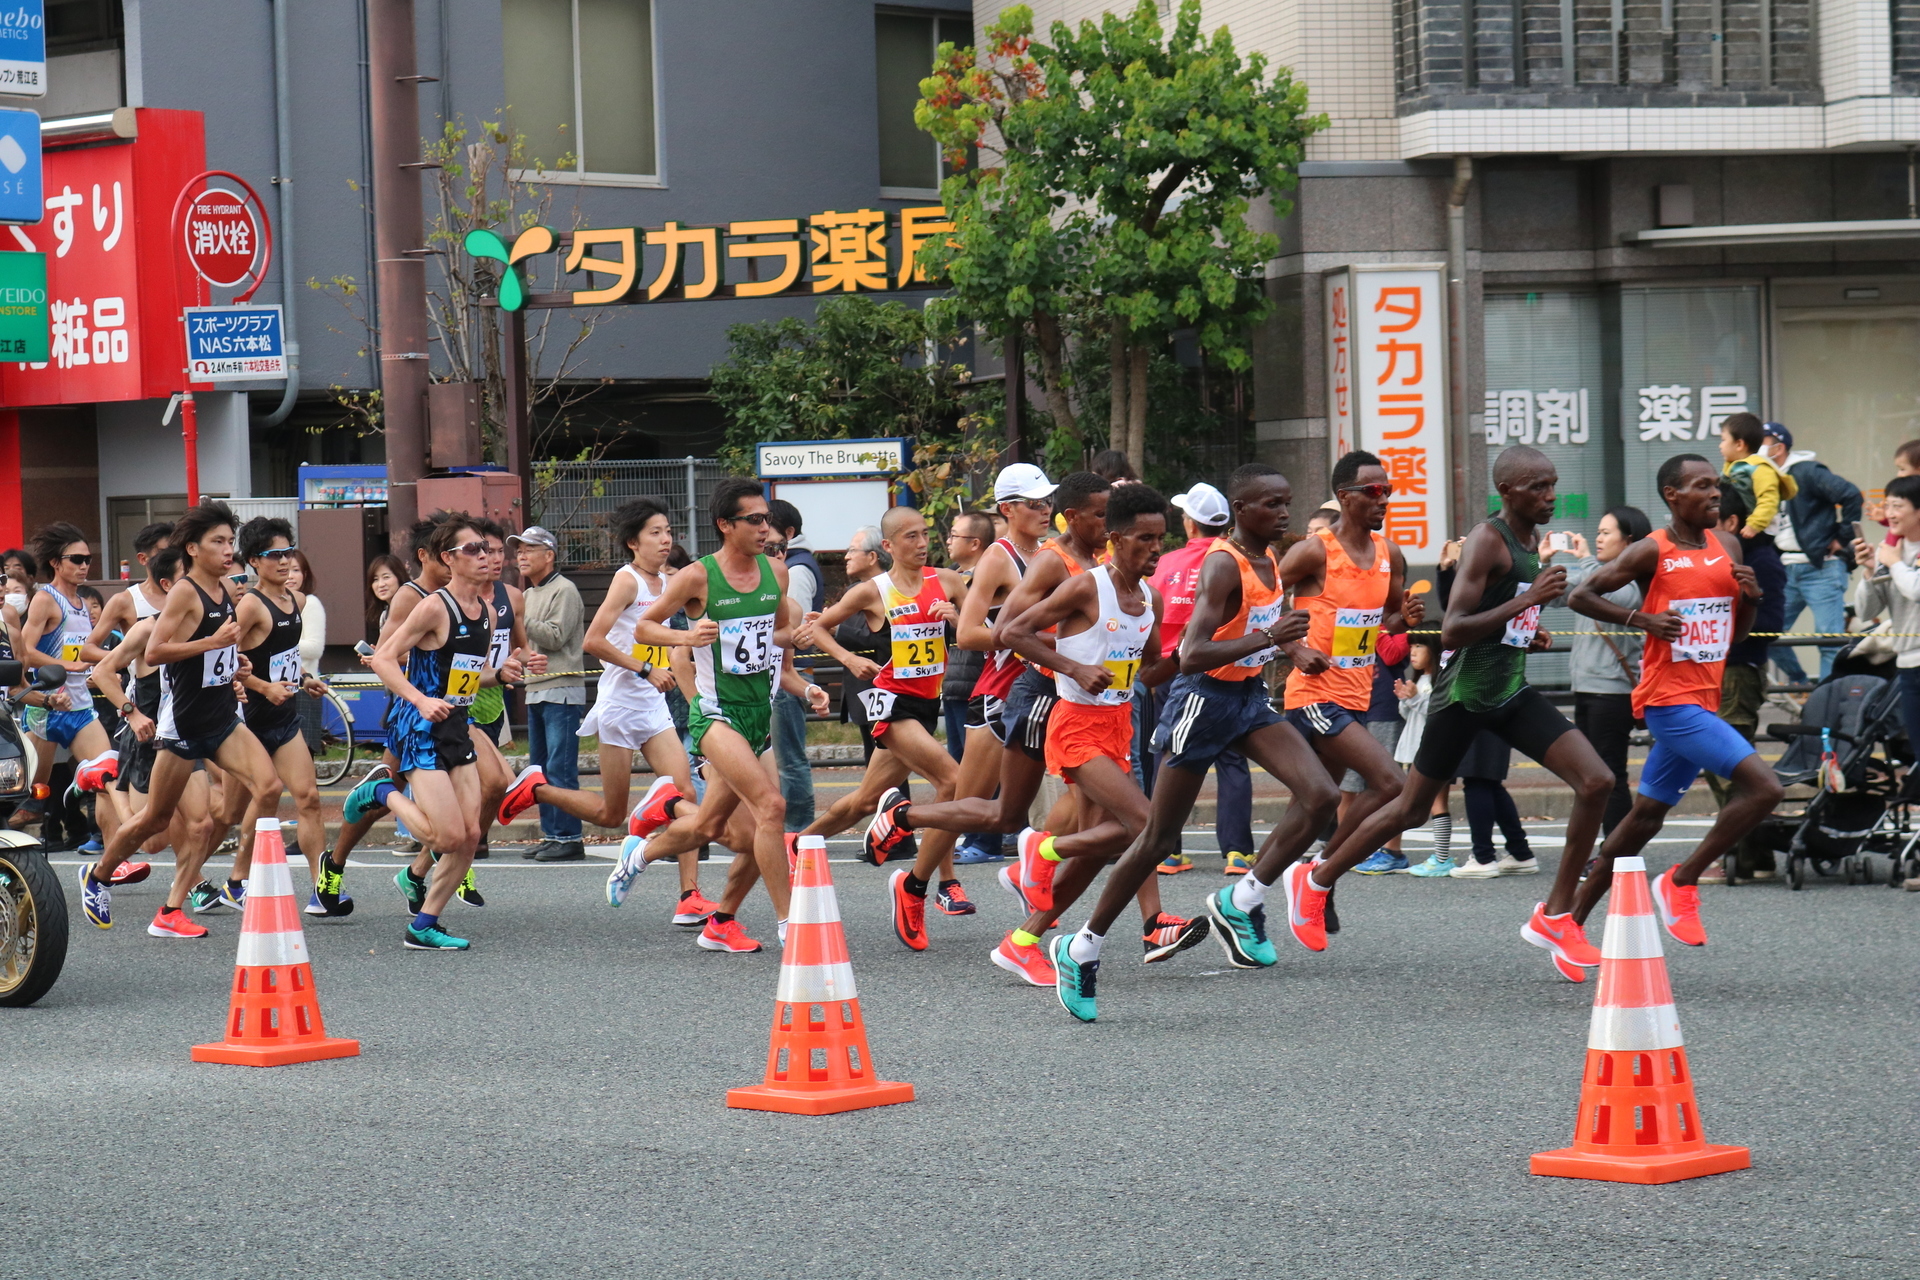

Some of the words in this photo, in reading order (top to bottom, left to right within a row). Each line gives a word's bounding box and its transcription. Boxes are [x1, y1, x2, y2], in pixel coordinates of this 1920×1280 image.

[0, 6, 42, 29] ebo
[0, 28, 28, 40] ETICS
[197, 205, 212, 214] FIRE
[213, 205, 241, 214] HYDRANT
[192, 220, 251, 254] 消火栓
[19, 297, 128, 371] 粧品
[193, 315, 275, 334] スポーツクラブ
[1374, 286, 1429, 550] タカラ薬局
[765, 452, 805, 468] Savoy
[808, 450, 833, 464] The
[838, 450, 897, 464] Bruette
[1698, 601, 1730, 614] マイナビ
[744, 618, 773, 631] マイナビ
[912, 626, 942, 638] マイナビ
[1678, 620, 1719, 646] PACE
[1722, 619, 1728, 642] 1
[735, 631, 767, 664] 65
[908, 641, 935, 665] 25
[1358, 629, 1369, 654] 4
[213, 646, 235, 677] 64
[280, 660, 299, 684] 62
[1126, 663, 1133, 688] 1
[869, 692, 888, 717] 25
